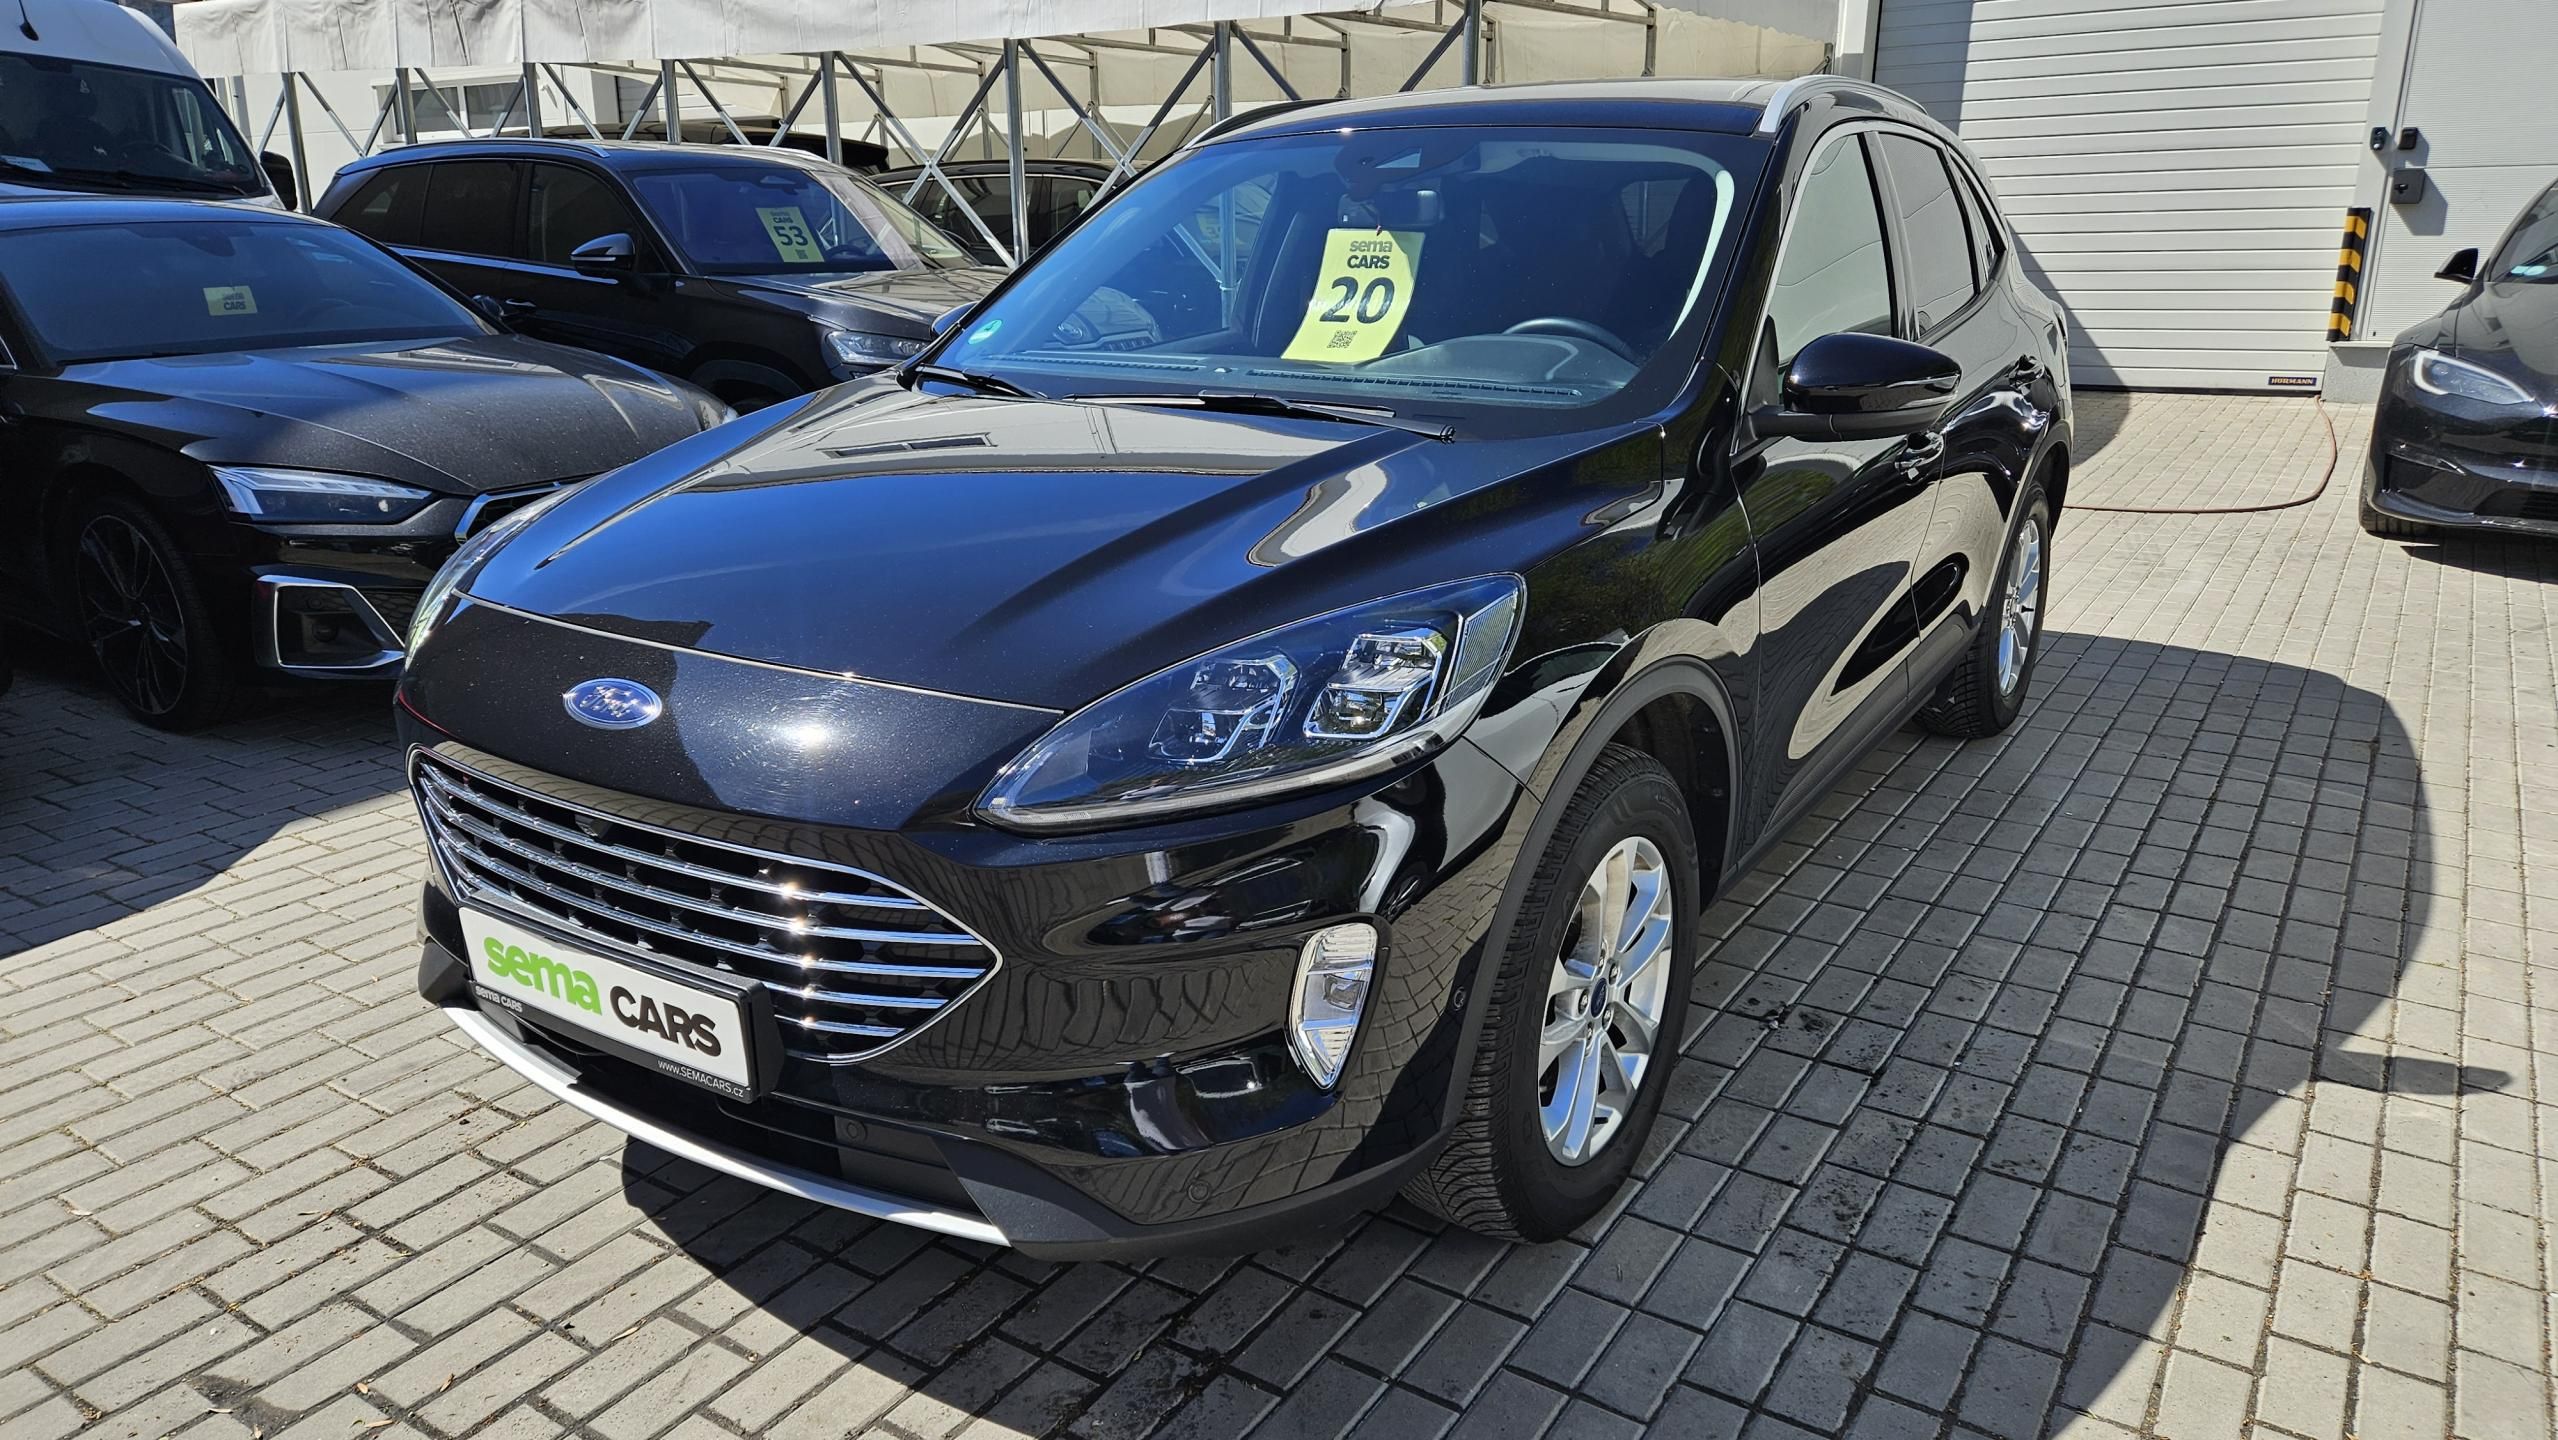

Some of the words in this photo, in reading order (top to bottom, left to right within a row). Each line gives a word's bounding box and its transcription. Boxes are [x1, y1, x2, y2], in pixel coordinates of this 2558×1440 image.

[773, 225, 809, 247] 53
[1349, 240, 1393, 253] sema
[1347, 255, 1391, 269] CARS
[1319, 276, 1395, 324] 20
[475, 985, 501, 1004] sema
[501, 996, 523, 1013] CARS
[483, 936, 603, 1017] sema
[609, 985, 722, 1058] CARS
[657, 1059, 744, 1098] www.SEMACARS.cz
